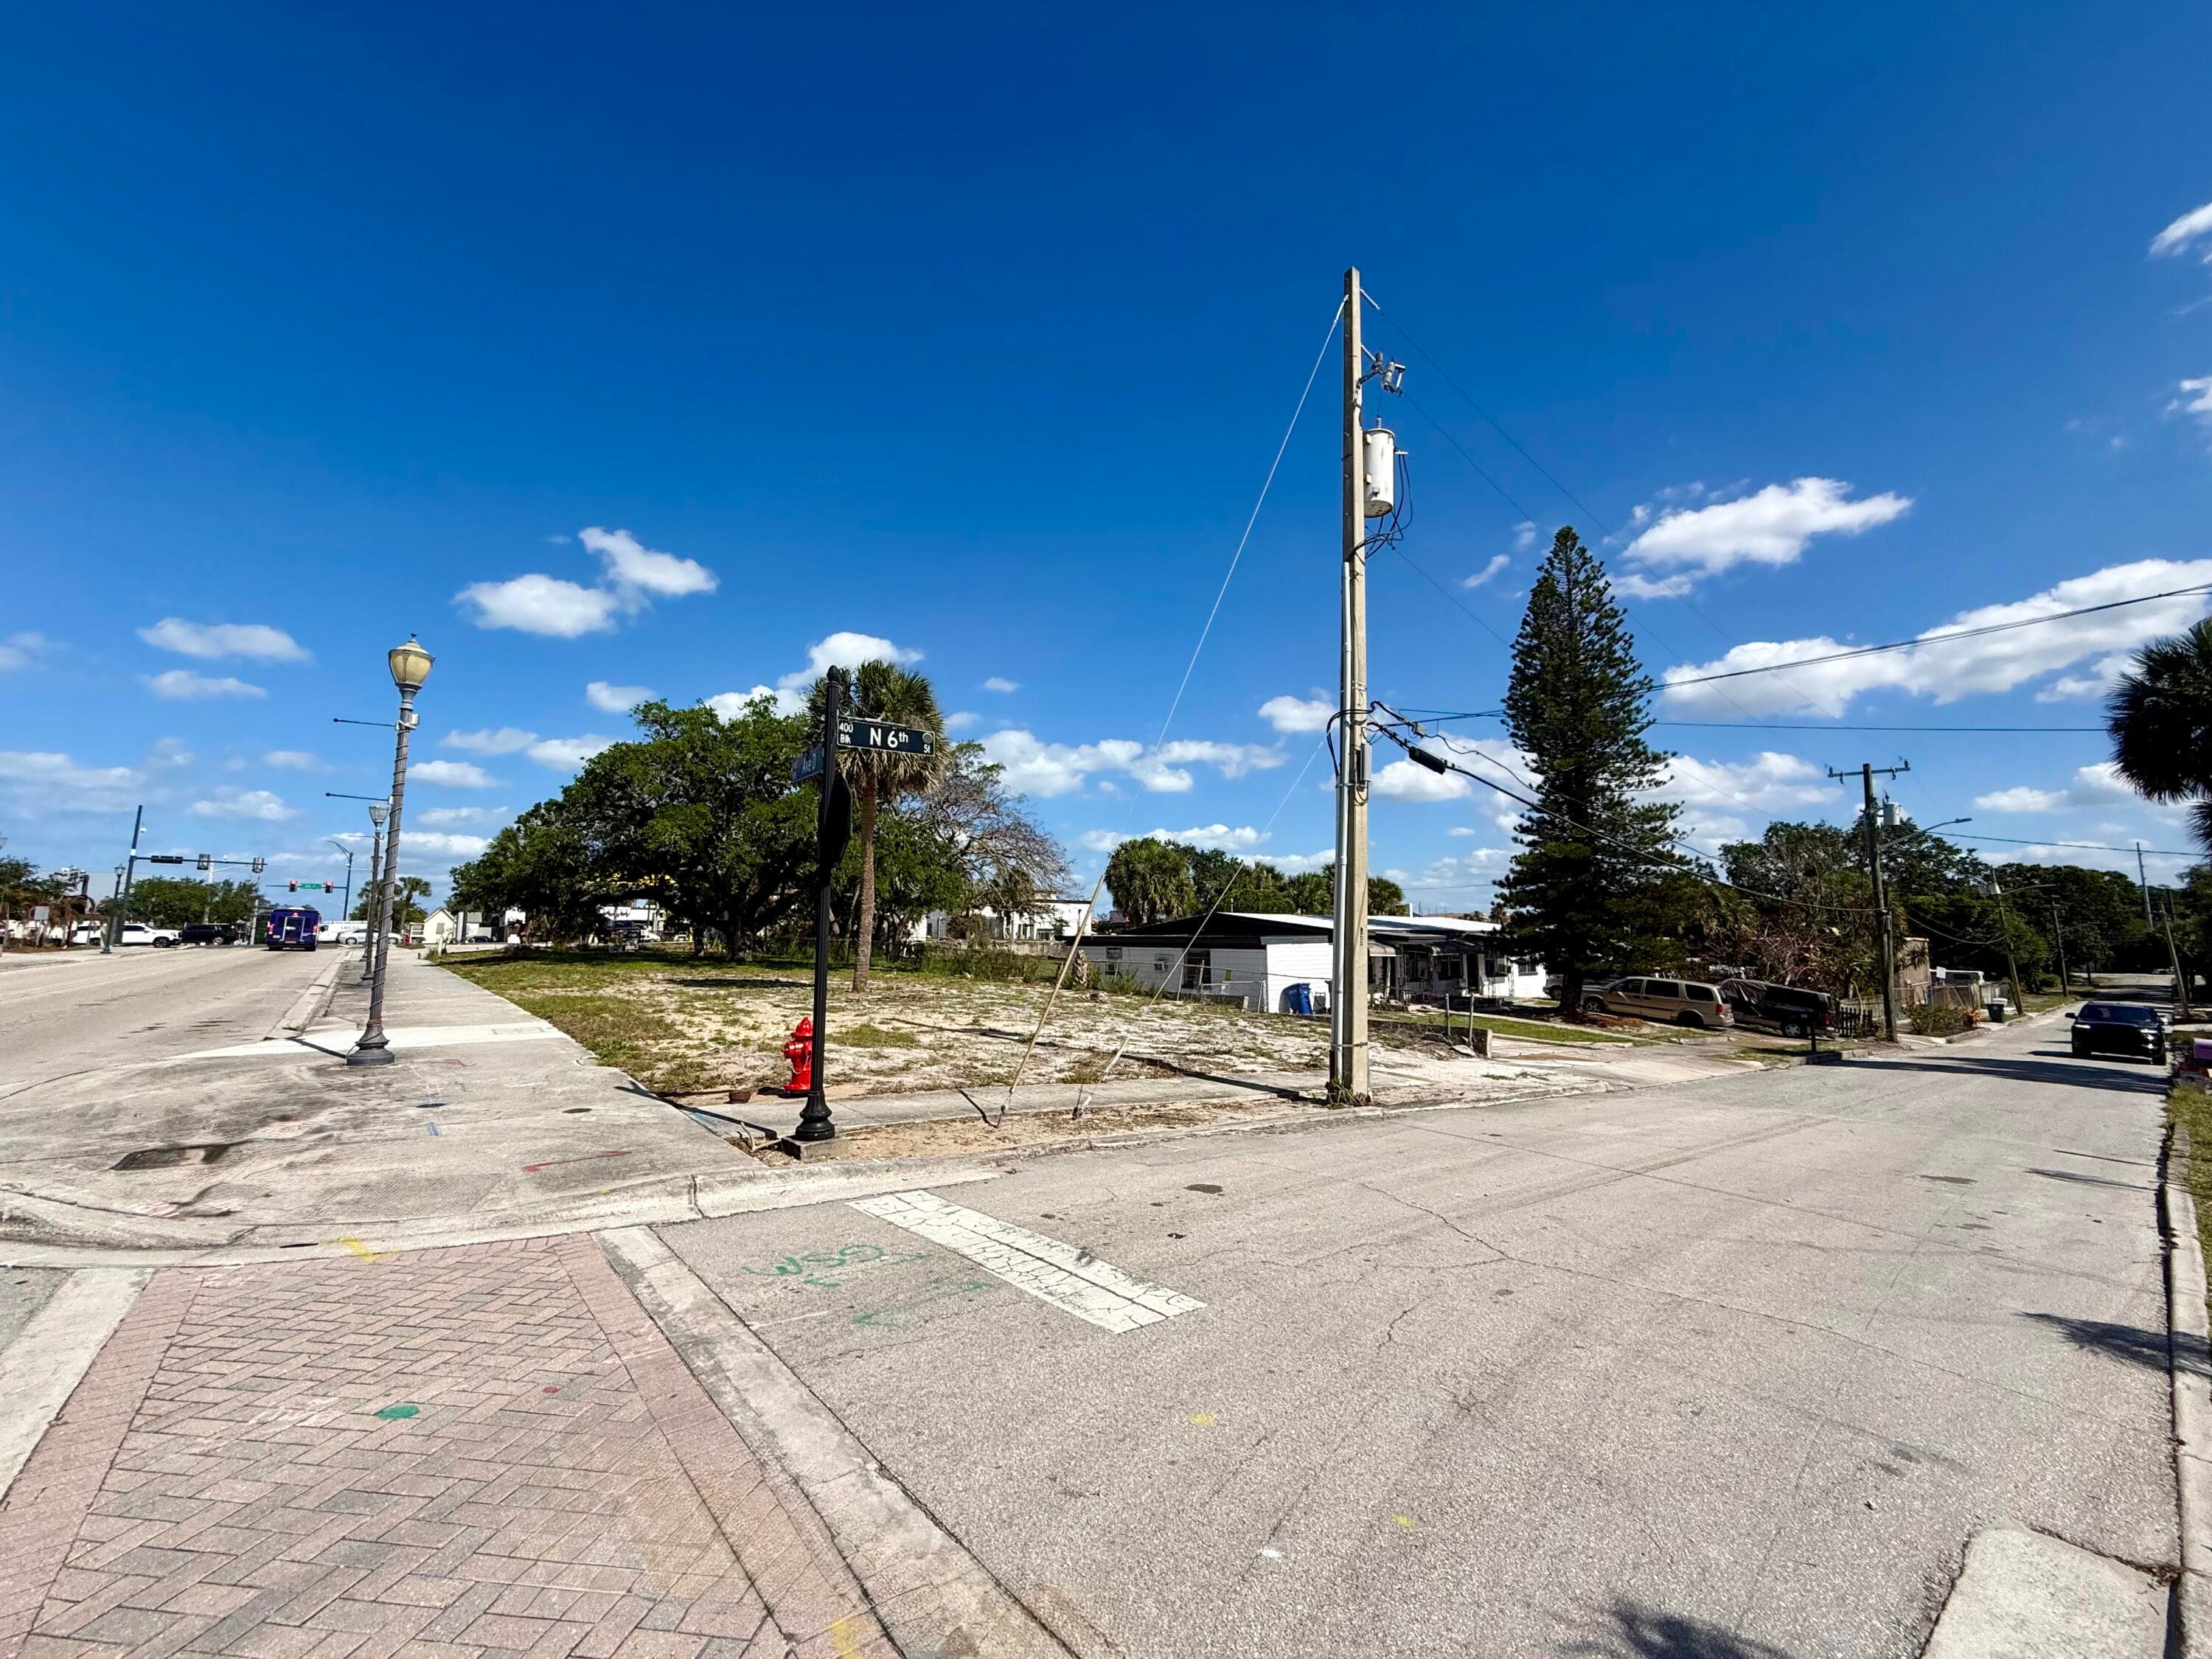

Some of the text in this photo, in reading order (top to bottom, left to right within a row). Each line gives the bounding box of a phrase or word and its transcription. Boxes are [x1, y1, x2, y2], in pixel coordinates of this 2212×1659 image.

[839, 723, 854, 733] 400
[840, 734, 852, 744] Blk
[869, 727, 908, 748] N 6th
[923, 744, 931, 754] St
